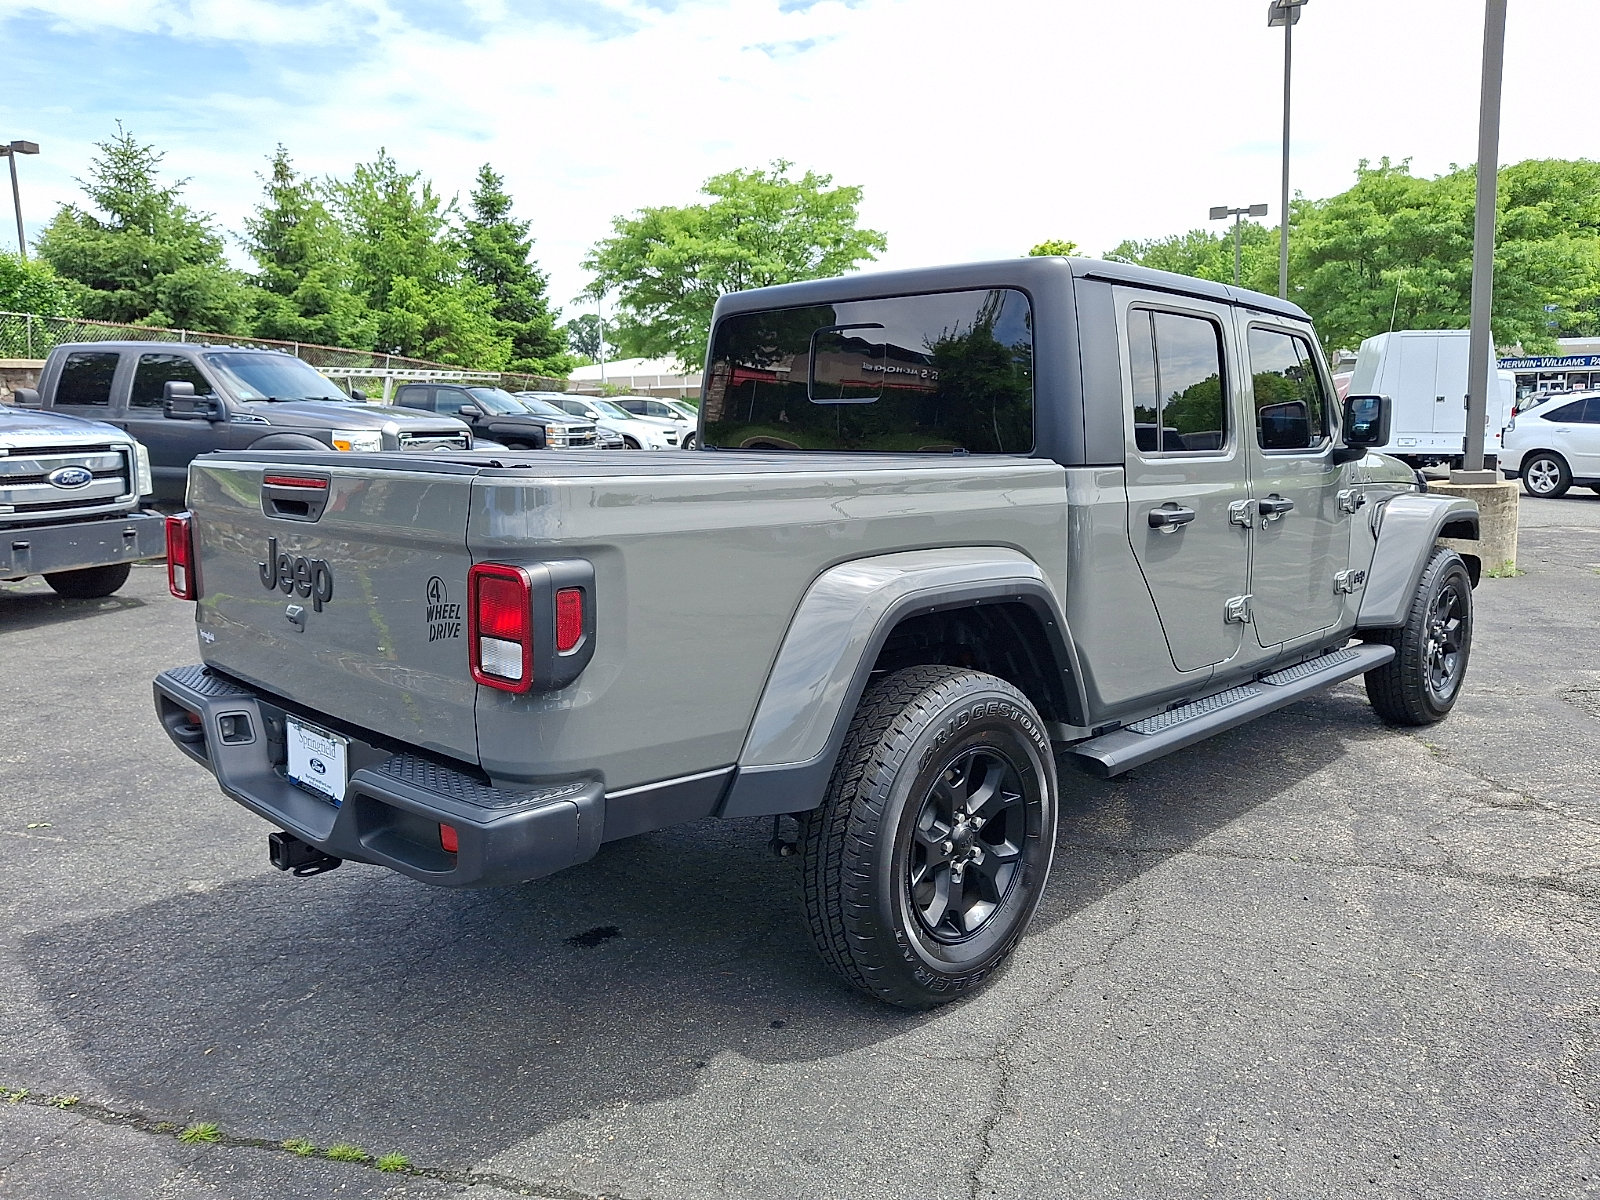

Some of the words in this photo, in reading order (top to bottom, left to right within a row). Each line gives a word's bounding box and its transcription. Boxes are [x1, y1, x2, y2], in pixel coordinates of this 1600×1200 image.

[1496, 357, 1585, 368] SHERWIN-WILLIAMS
[61, 471, 85, 484] Ford
[258, 536, 334, 613] Jeep
[426, 603, 461, 623] WHEEL
[428, 622, 461, 643] DRIVE
[298, 729, 337, 759] Springfield
[917, 701, 1049, 774] BRIDGESTONE
